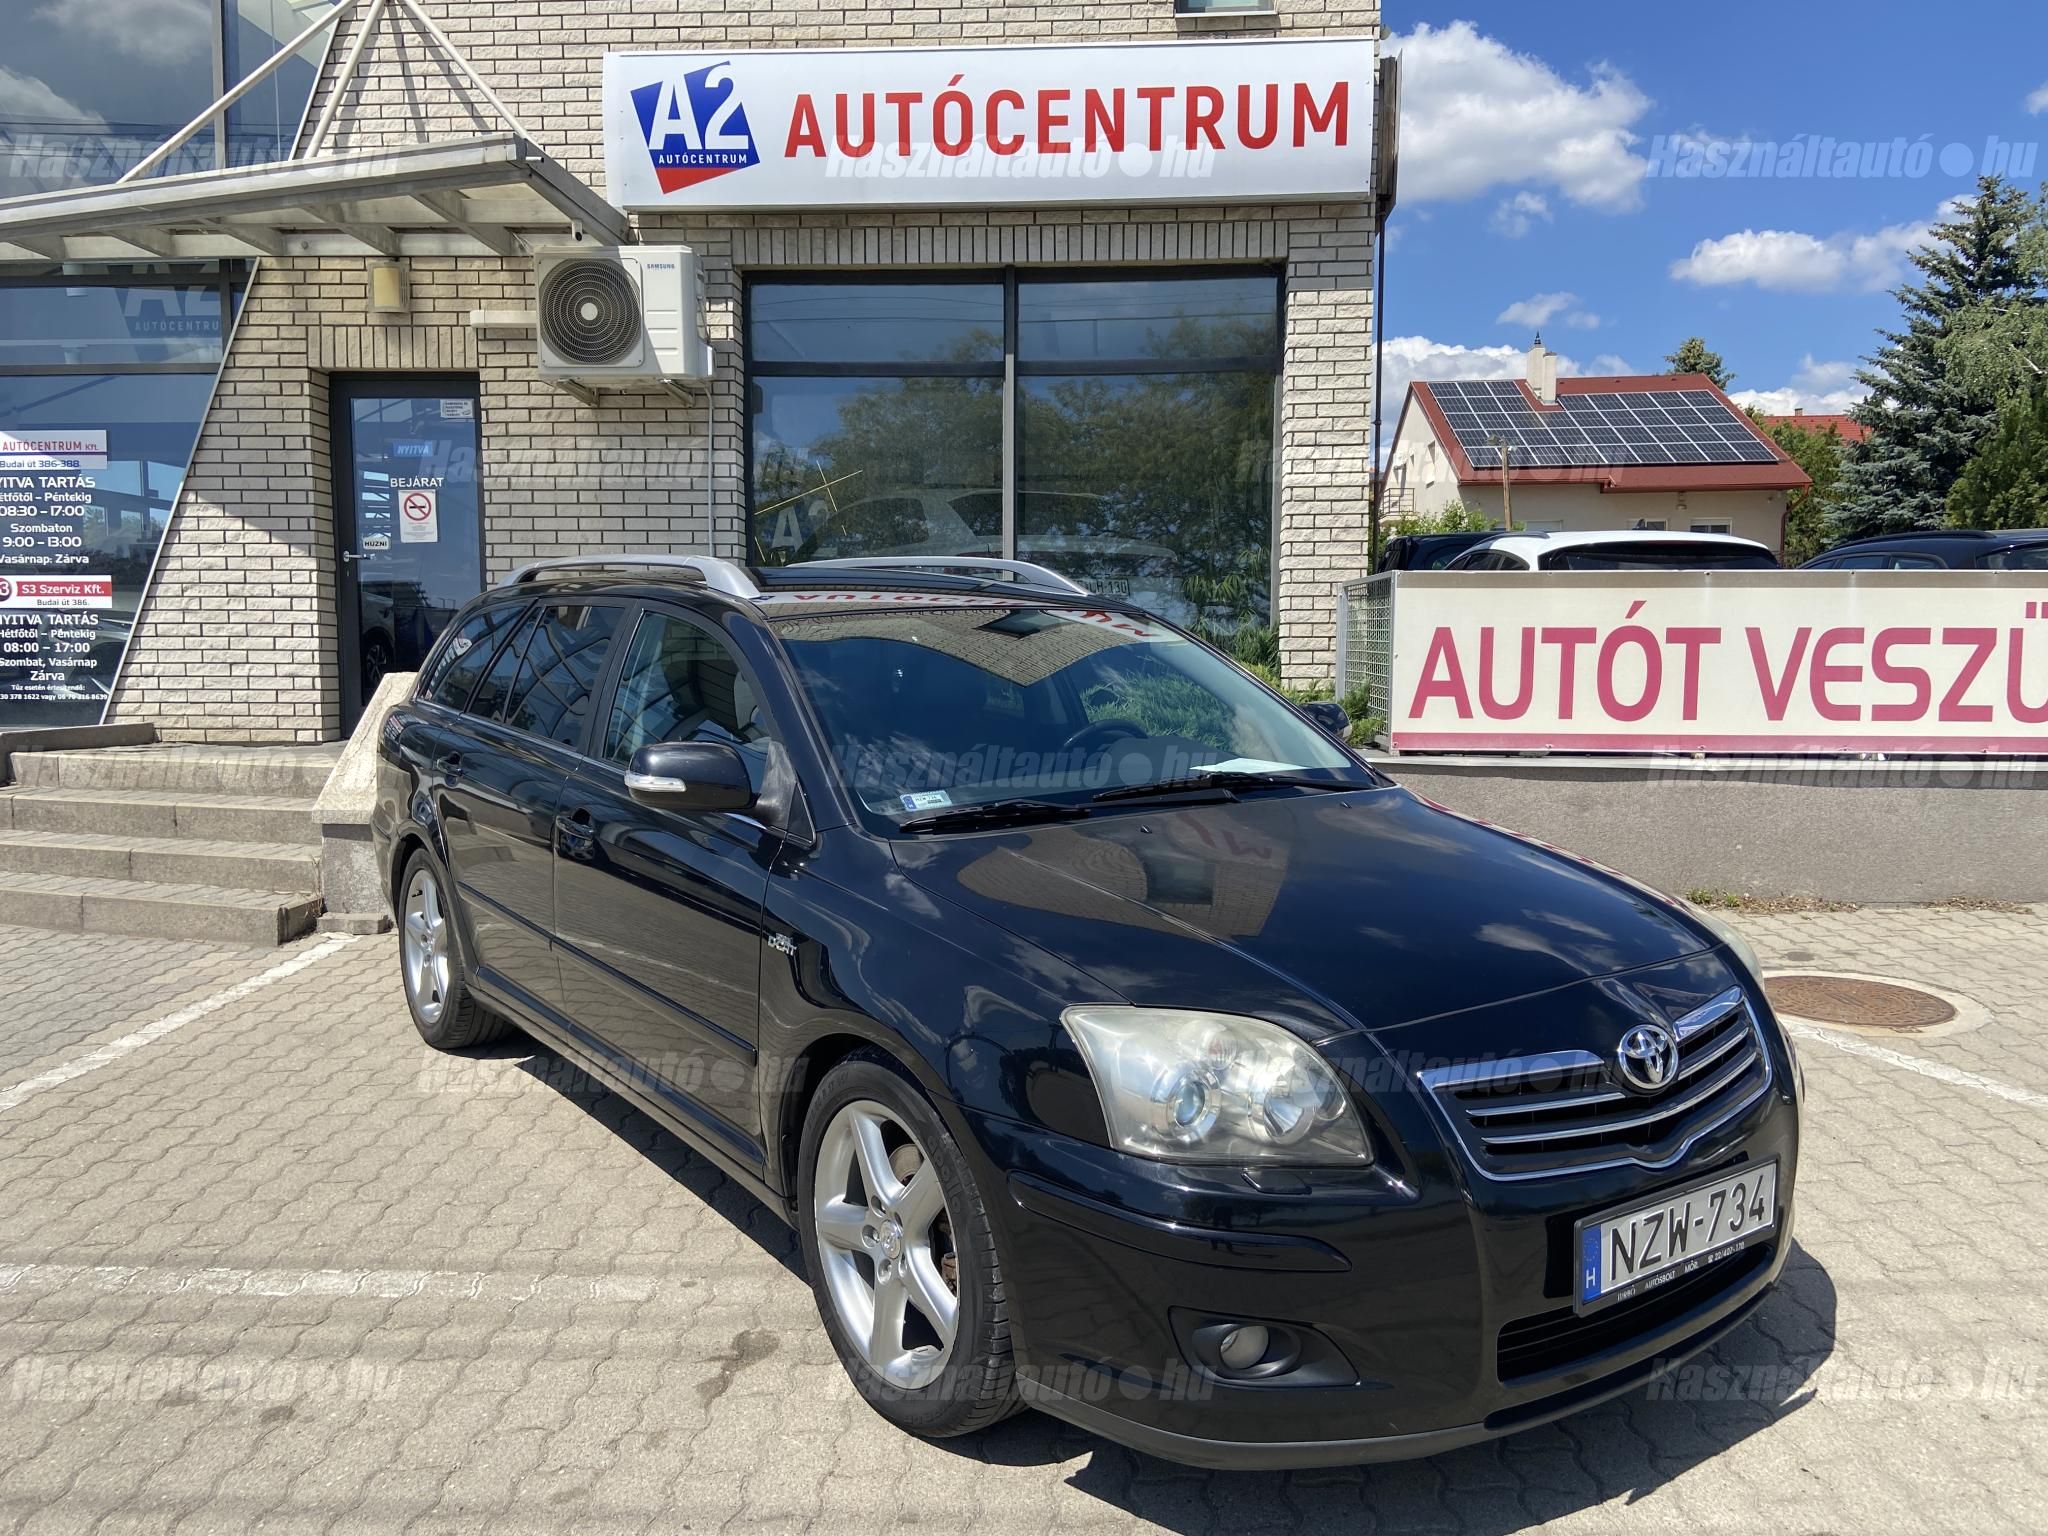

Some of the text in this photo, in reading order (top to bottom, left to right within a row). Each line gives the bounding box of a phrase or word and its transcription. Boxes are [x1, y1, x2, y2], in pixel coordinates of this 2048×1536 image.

[648, 64, 749, 150] A2
[784, 74, 1349, 158] AUTÓCENTRUM
[658, 151, 748, 165] AUTÓCENTRUM
[3, 439, 82, 451] AUTÓCENTRUM
[0, 460, 25, 468] Budai
[39, 473, 96, 488] TARTÁS
[390, 475, 444, 488] BEJÁRAT
[44, 492, 92, 503] Péntekig
[0, 505, 37, 516] 08:30
[51, 505, 84, 516] 17:00
[10, 523, 73, 533] Szombaton
[3, 536, 35, 547] 9:00
[47, 536, 82, 547] 13:00
[55, 554, 89, 564] Zárva
[21, 584, 105, 594] S3 Szerviz Kft.
[37, 599, 60, 607] Budai
[61, 598, 70, 607] út
[47, 611, 99, 625] TARTÁS
[51, 629, 96, 640] Péntekig
[3, 642, 39, 653] 08:00
[54, 642, 90, 653] 17:00
[48, 657, 98, 668] Vasárnap
[1407, 600, 2048, 724] AUTÓT VESZÜ
[30, 670, 65, 681] Zárva
[1609, 1174, 1766, 1282] NZW-734
[1585, 1267, 1597, 1289] H
